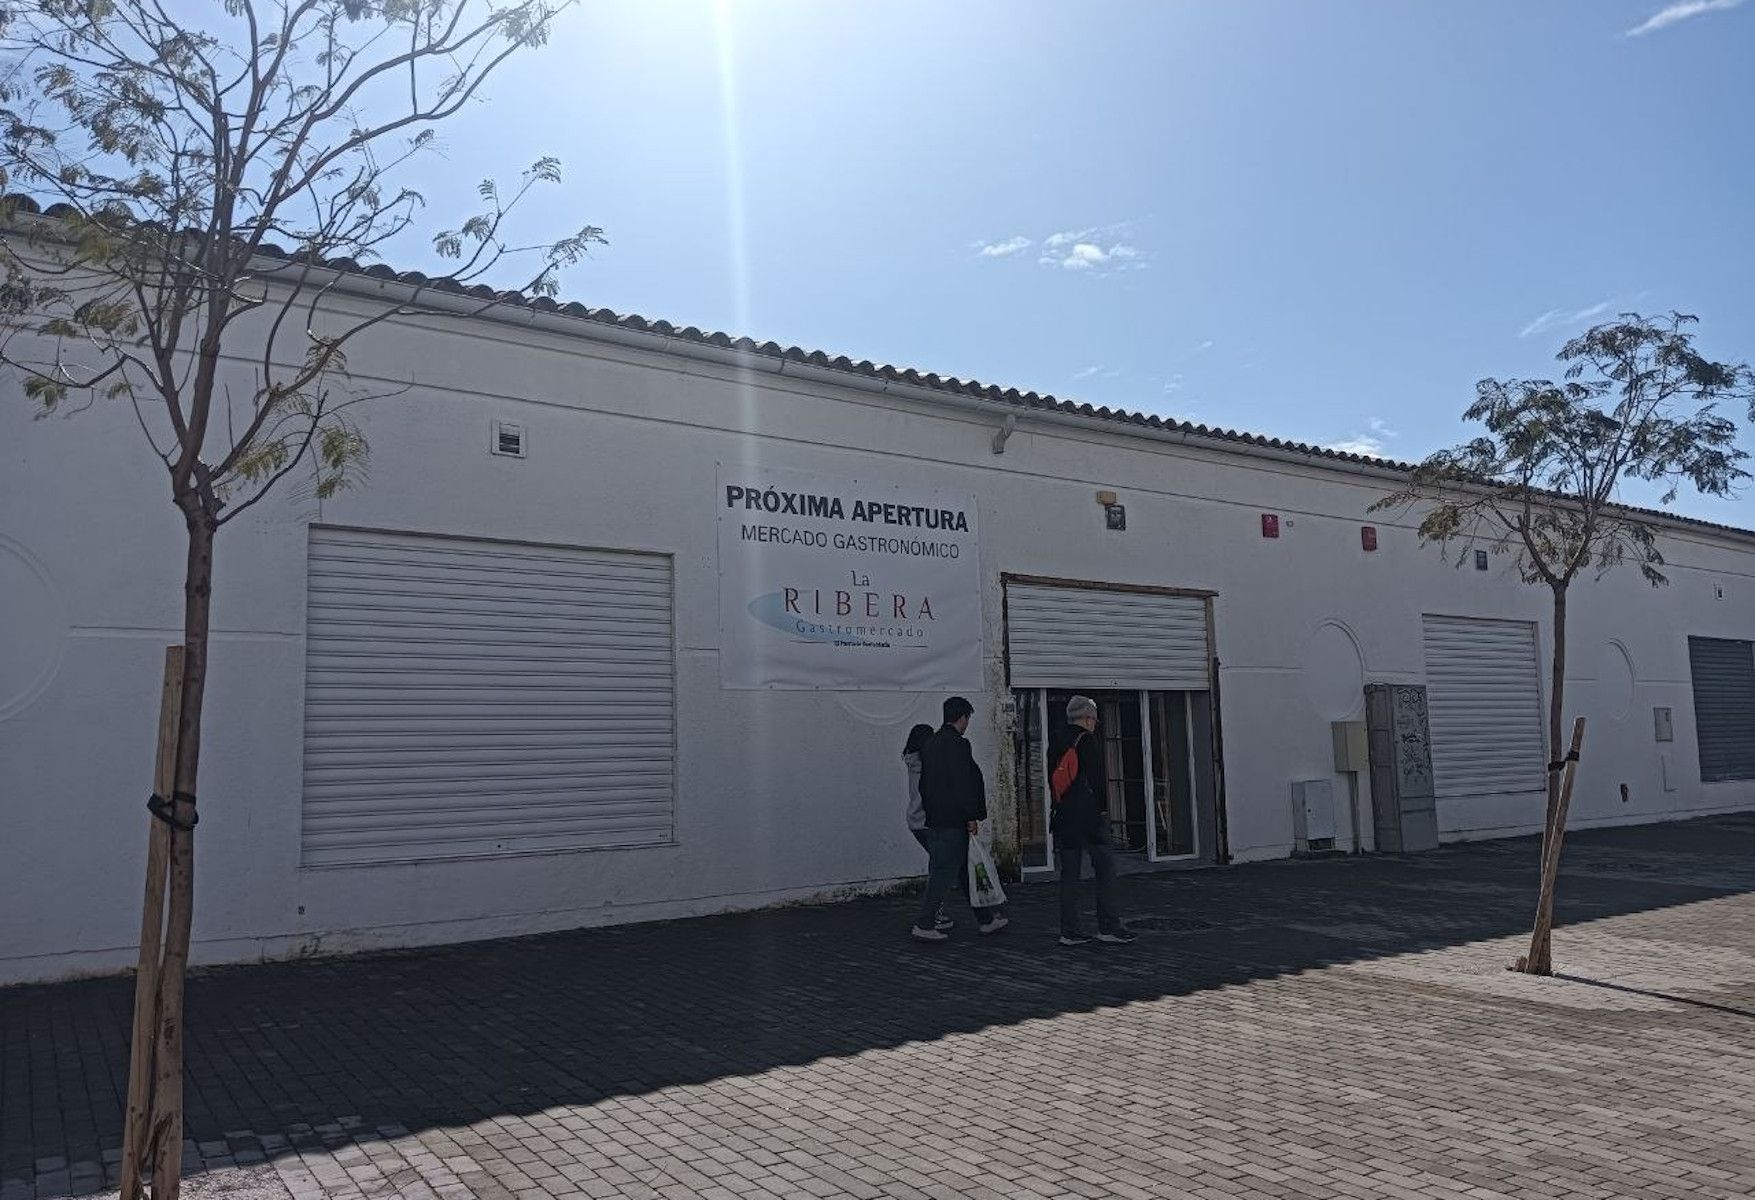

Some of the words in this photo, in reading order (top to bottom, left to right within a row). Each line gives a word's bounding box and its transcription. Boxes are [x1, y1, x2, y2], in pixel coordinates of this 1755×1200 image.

[726, 485, 845, 520] PRÓXIMA
[851, 500, 969, 532] APERTURA
[741, 524, 828, 548] MERCADO
[833, 533, 960, 559] GASTRONÓMICO
[850, 570, 870, 587] La
[784, 587, 935, 621] RIBERA
[796, 619, 925, 638] Gastromercado
